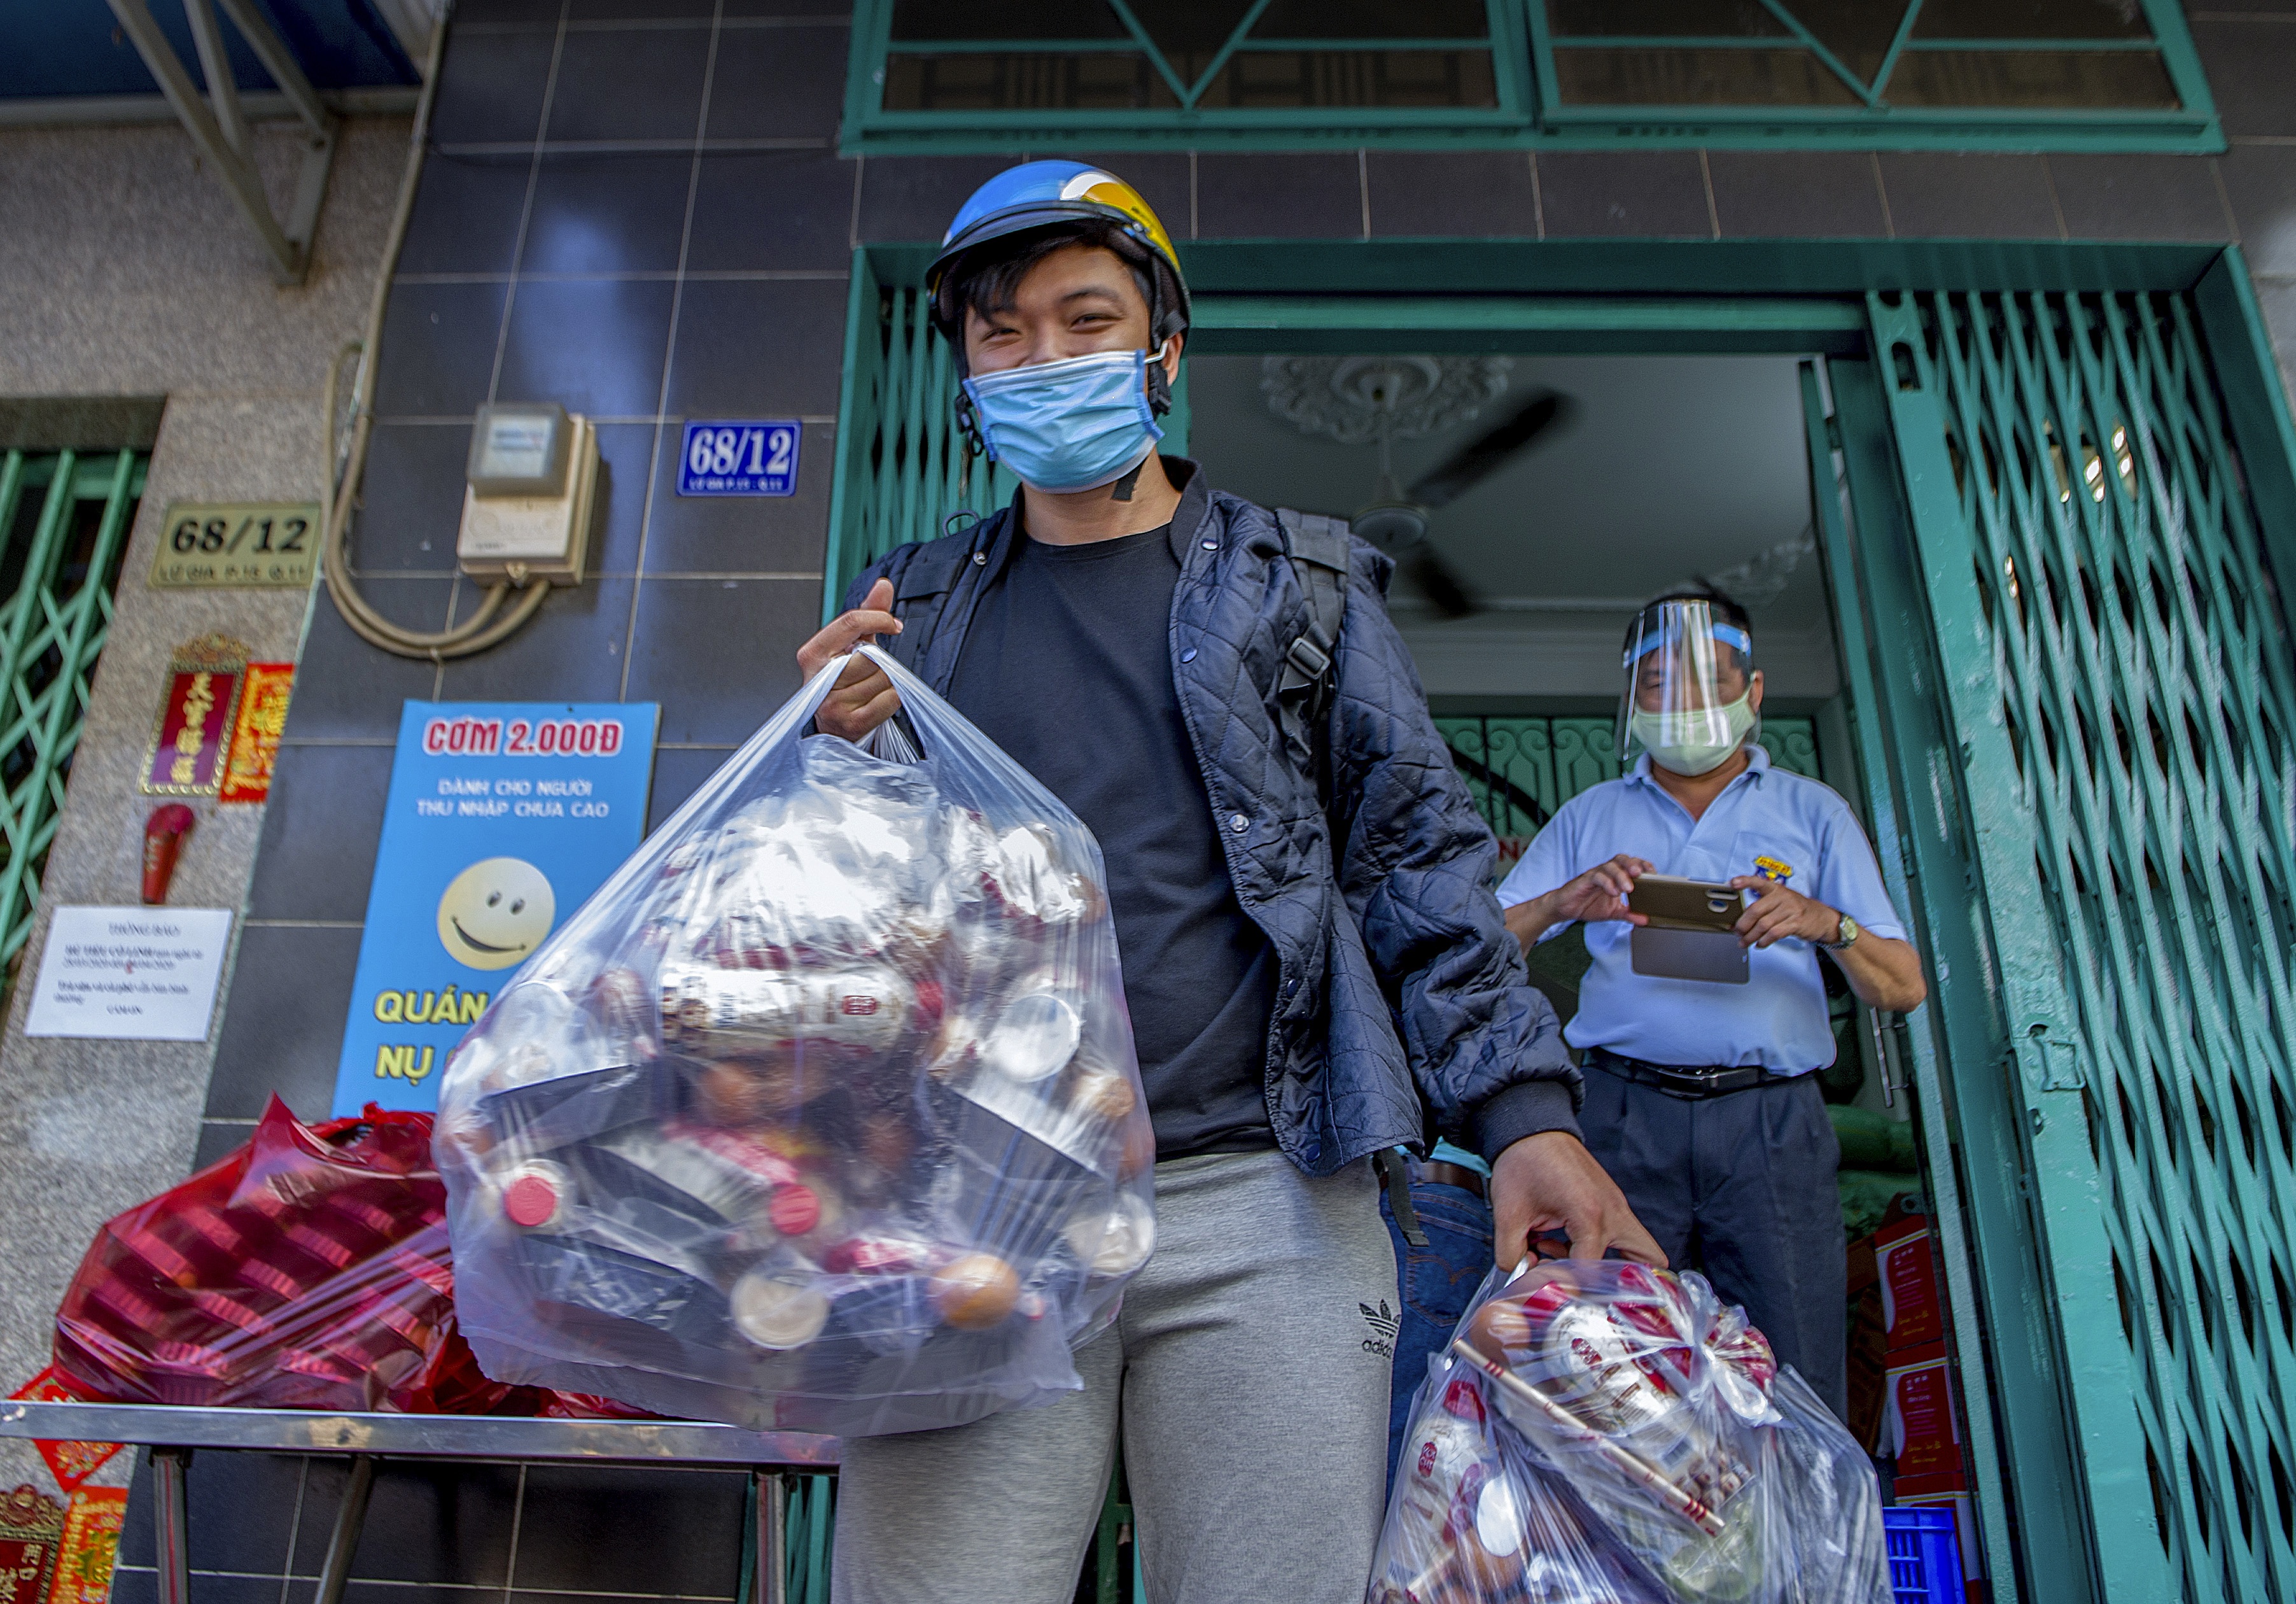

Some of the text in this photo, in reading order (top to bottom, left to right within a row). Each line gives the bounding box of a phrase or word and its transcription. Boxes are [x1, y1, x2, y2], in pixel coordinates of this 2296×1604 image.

[689, 428, 792, 475] 68/12
[170, 515, 307, 554] 68/12
[426, 720, 621, 754] CƠM 2.000Đ
[438, 777, 490, 796] DÀNH
[494, 778, 532, 796] CHO
[417, 799, 454, 817] THU
[457, 798, 509, 820] NHẬP
[570, 801, 610, 818] CAO
[374, 984, 489, 1024] QUÁN
[375, 1045, 435, 1087] NỤ
